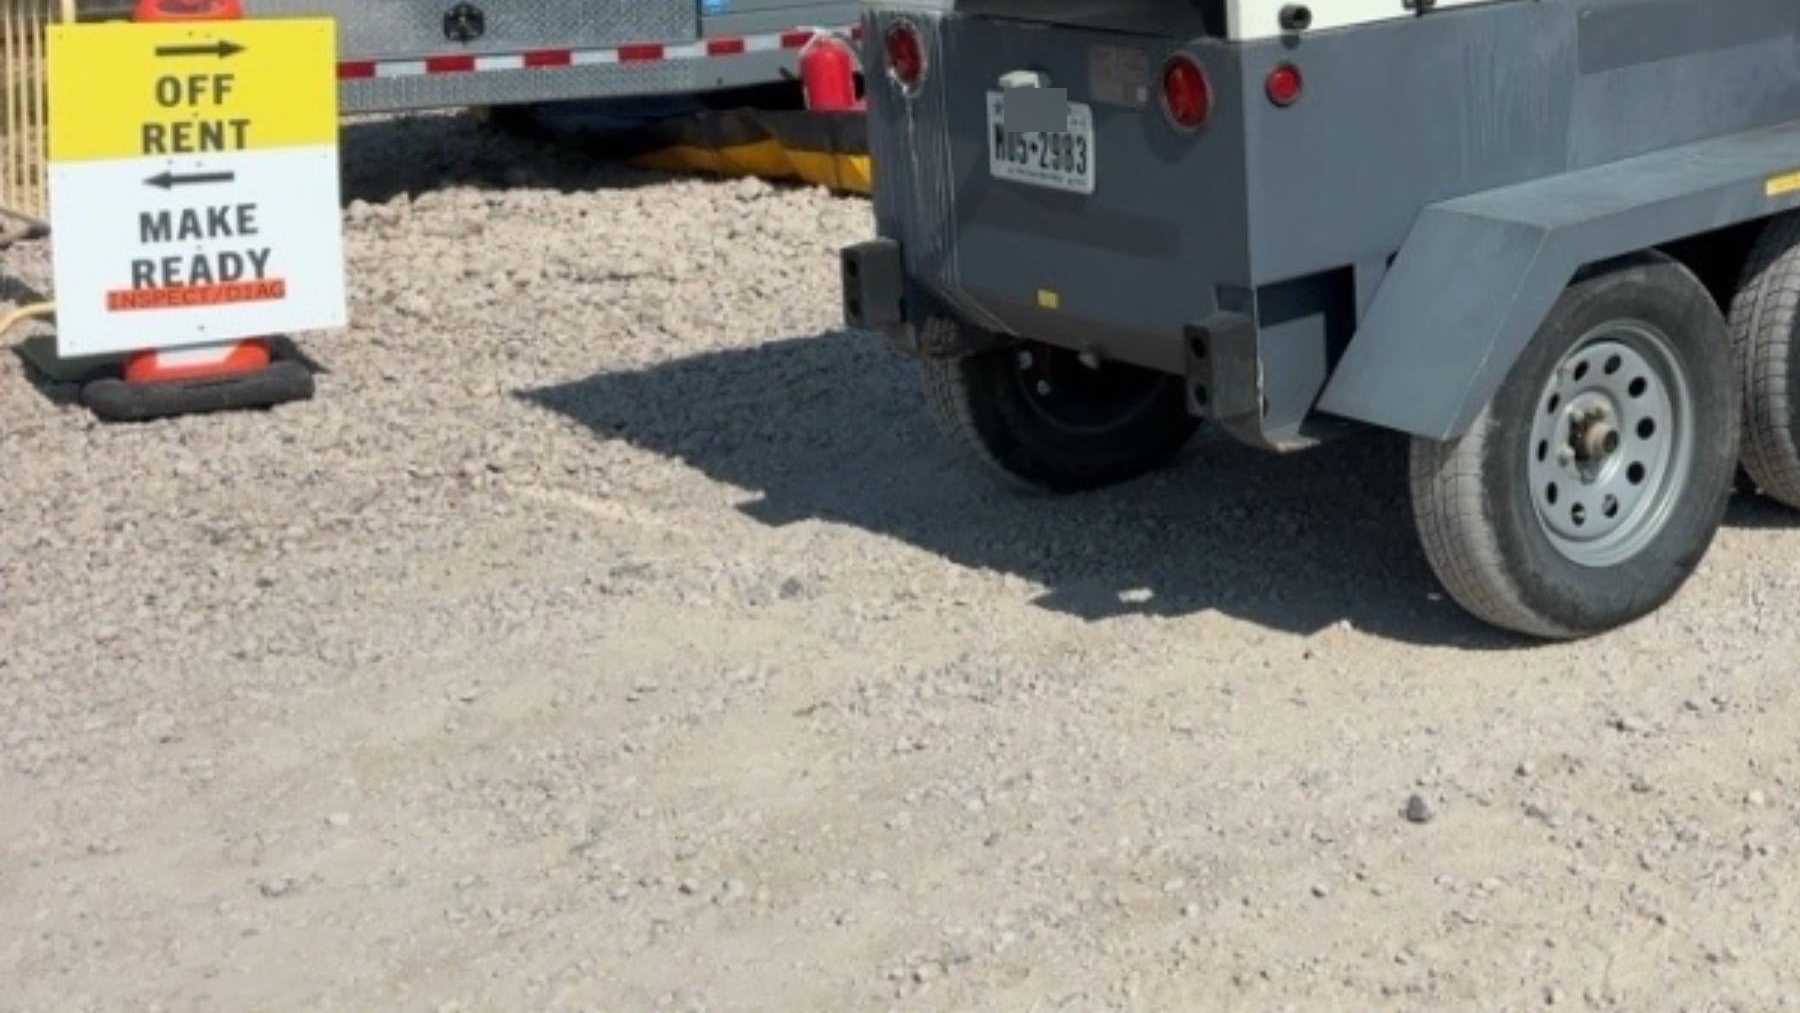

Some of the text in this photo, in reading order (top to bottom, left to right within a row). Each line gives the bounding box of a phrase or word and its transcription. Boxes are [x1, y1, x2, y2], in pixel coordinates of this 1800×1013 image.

[155, 73, 234, 107] OFF
[142, 119, 250, 155] RENT
[139, 203, 258, 244] MAKE
[131, 248, 271, 290] READY
